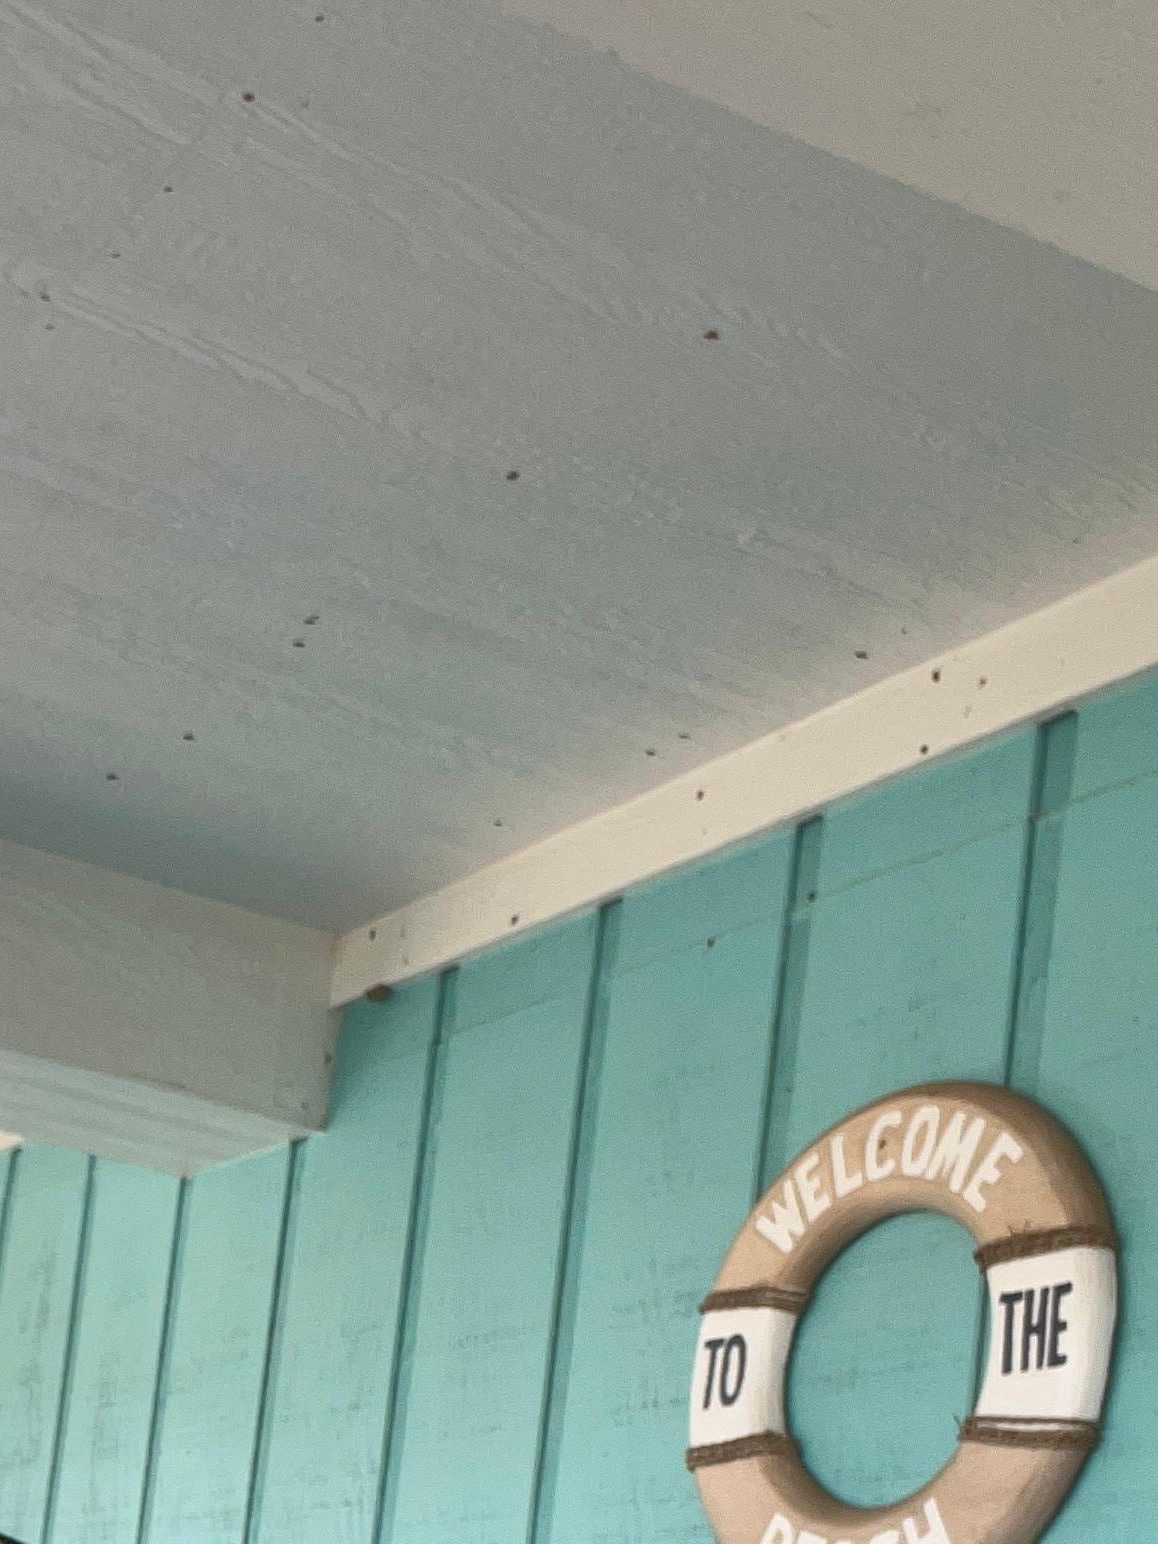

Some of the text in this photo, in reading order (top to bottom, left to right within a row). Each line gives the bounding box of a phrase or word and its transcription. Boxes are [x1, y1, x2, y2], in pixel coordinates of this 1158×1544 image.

[755, 1105, 1024, 1253] WELCOME
[702, 1281, 1072, 1409] TO THE
